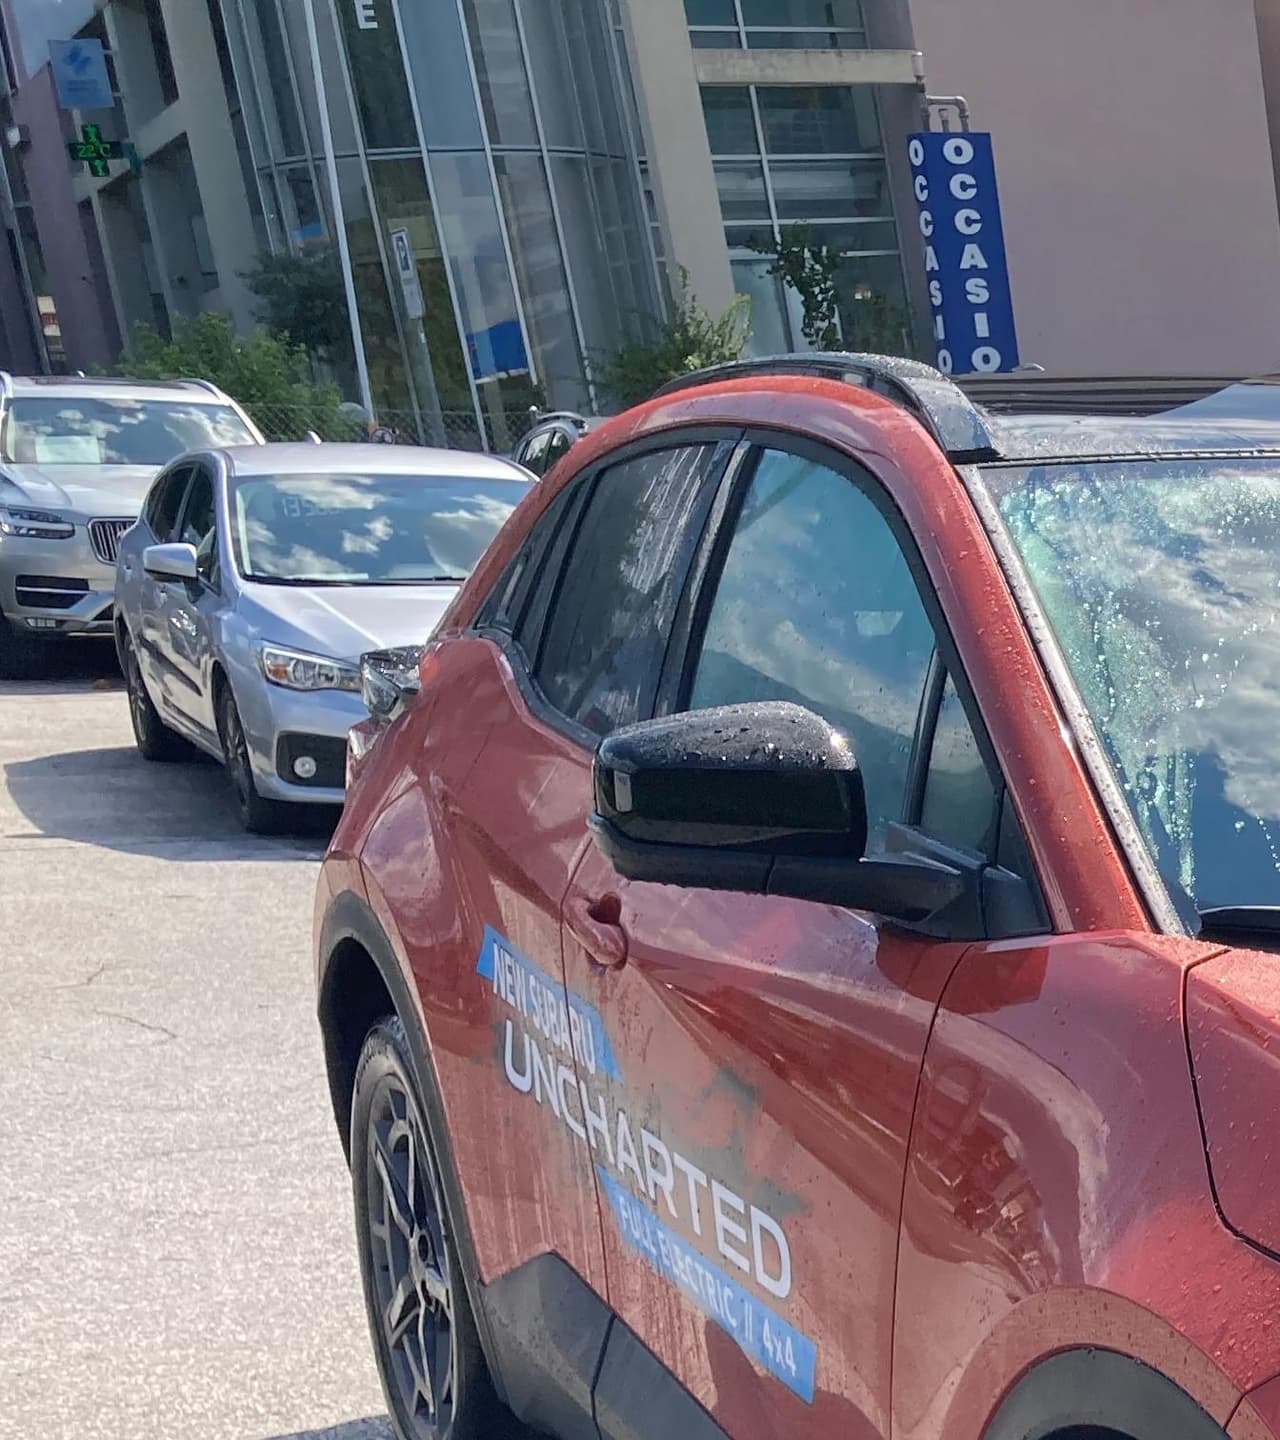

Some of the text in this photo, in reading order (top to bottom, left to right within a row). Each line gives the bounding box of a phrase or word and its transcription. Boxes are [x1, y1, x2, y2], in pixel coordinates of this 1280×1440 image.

[493, 943, 596, 1075] NEW SUBARU
[504, 1018, 791, 1298] UNCHARTED
[619, 1196, 657, 1255] FULL
[657, 1230, 738, 1328] ELECTRIC
[763, 1318, 796, 1377] 4x4
